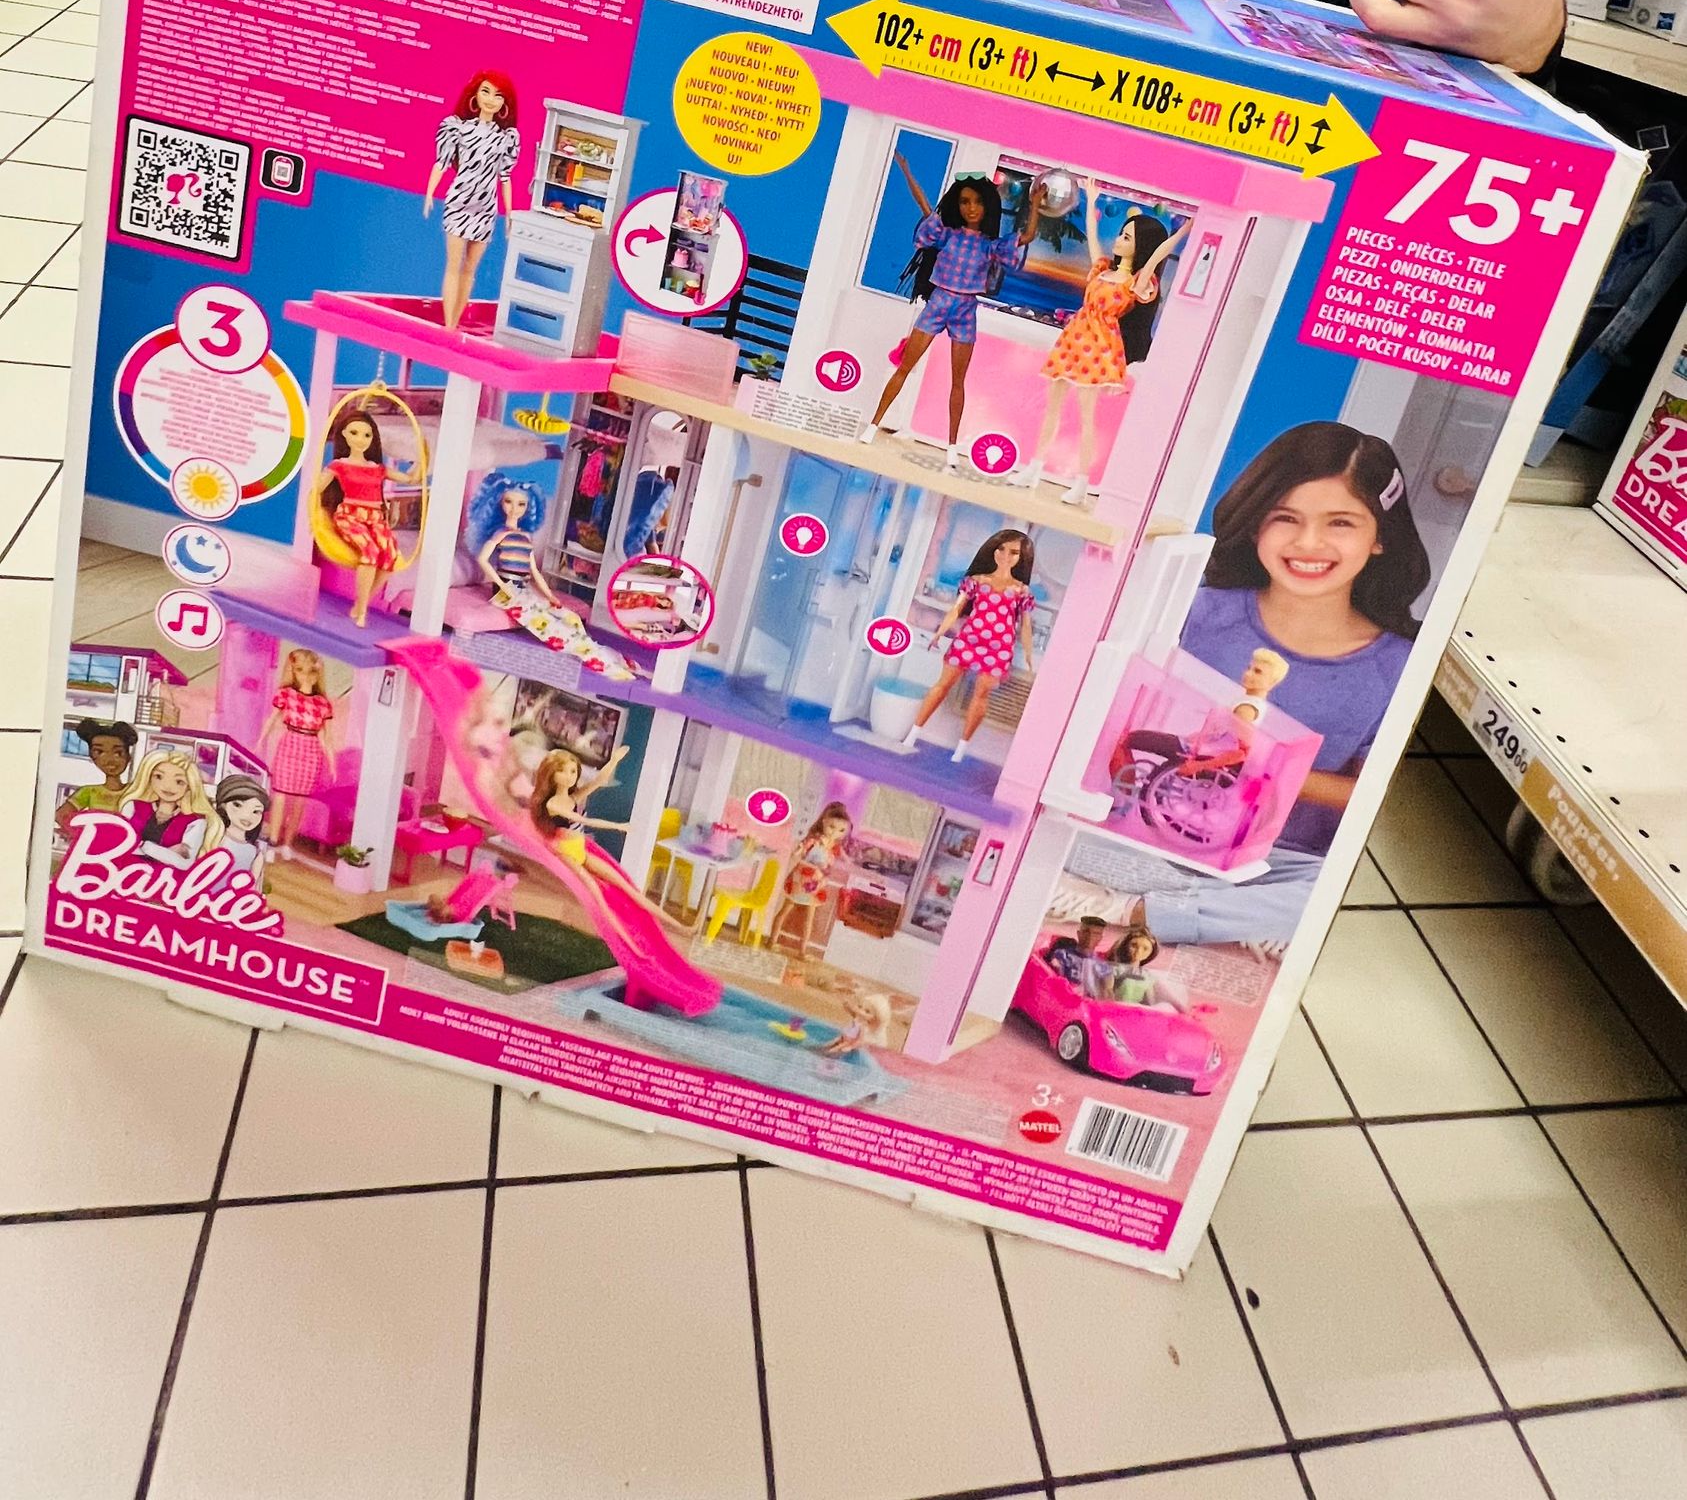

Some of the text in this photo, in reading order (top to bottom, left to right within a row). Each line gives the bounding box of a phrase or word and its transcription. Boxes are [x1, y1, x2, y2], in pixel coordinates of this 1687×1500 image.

[712, 50, 799, 79] NOUVEAU NEU!
[746, 41, 773, 56] NEW!
[710, 66, 795, 95] NUOVO! NIEUW!
[874, 11, 924, 50] 102+
[929, 34, 962, 63] cm
[969, 37, 1005, 70] (3+
[1009, 46, 1038, 83] ft)
[1132, 75, 1183, 114] 108+
[1187, 97, 1222, 127] cm
[1229, 101, 1265, 134] (3+
[1269, 110, 1299, 147] ft)
[686, 93, 805, 131] UUTTA! NYHED! NYTT!
[736, 89, 767, 105] NOVA!
[775, 99, 812, 116] NYHET!
[714, 134, 762, 154] NOVINKA!
[757, 128, 780, 141] NEO!
[1383, 138, 1585, 245] 75+
[1339, 245, 1486, 296] PEZZI ONDERDELEN
[1346, 226, 1508, 280] PIECES PIÈCES TEILE
[1325, 285, 1466, 333] OSAA DELE DELER
[1331, 265, 1496, 320] PIEZAS PEÇAS DELAR
[199, 301, 245, 357] 3
[1318, 303, 1408, 338] ELEMENTÓW
[1311, 322, 1512, 386] DÍLŮ POČET KUSOV DARAB
[56, 811, 282, 933] Barbie
[53, 901, 355, 1005] DREAMHOUSE
[1031, 1083, 1065, 1107] 3+
[1019, 1121, 1063, 1134] MATTEL
